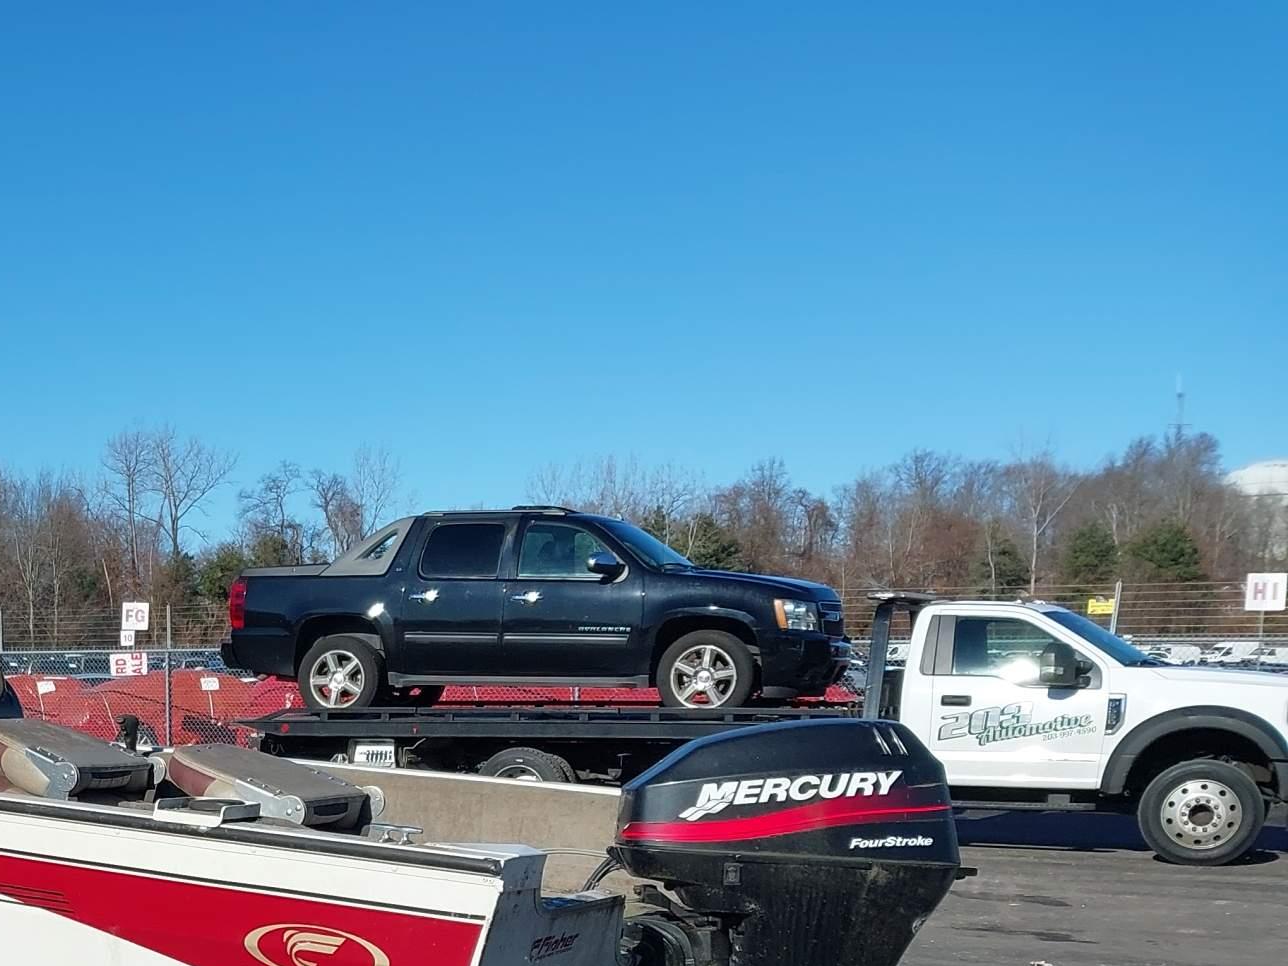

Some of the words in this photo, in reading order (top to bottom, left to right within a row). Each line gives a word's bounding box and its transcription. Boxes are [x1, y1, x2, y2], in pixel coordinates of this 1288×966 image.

[125, 608, 146, 623] FG
[123, 633, 133, 642] 10
[938, 702, 1034, 741] 203
[976, 713, 1093, 746] Automotive
[682, 770, 903, 817] MERCURY
[849, 835, 934, 850] FourStroke
